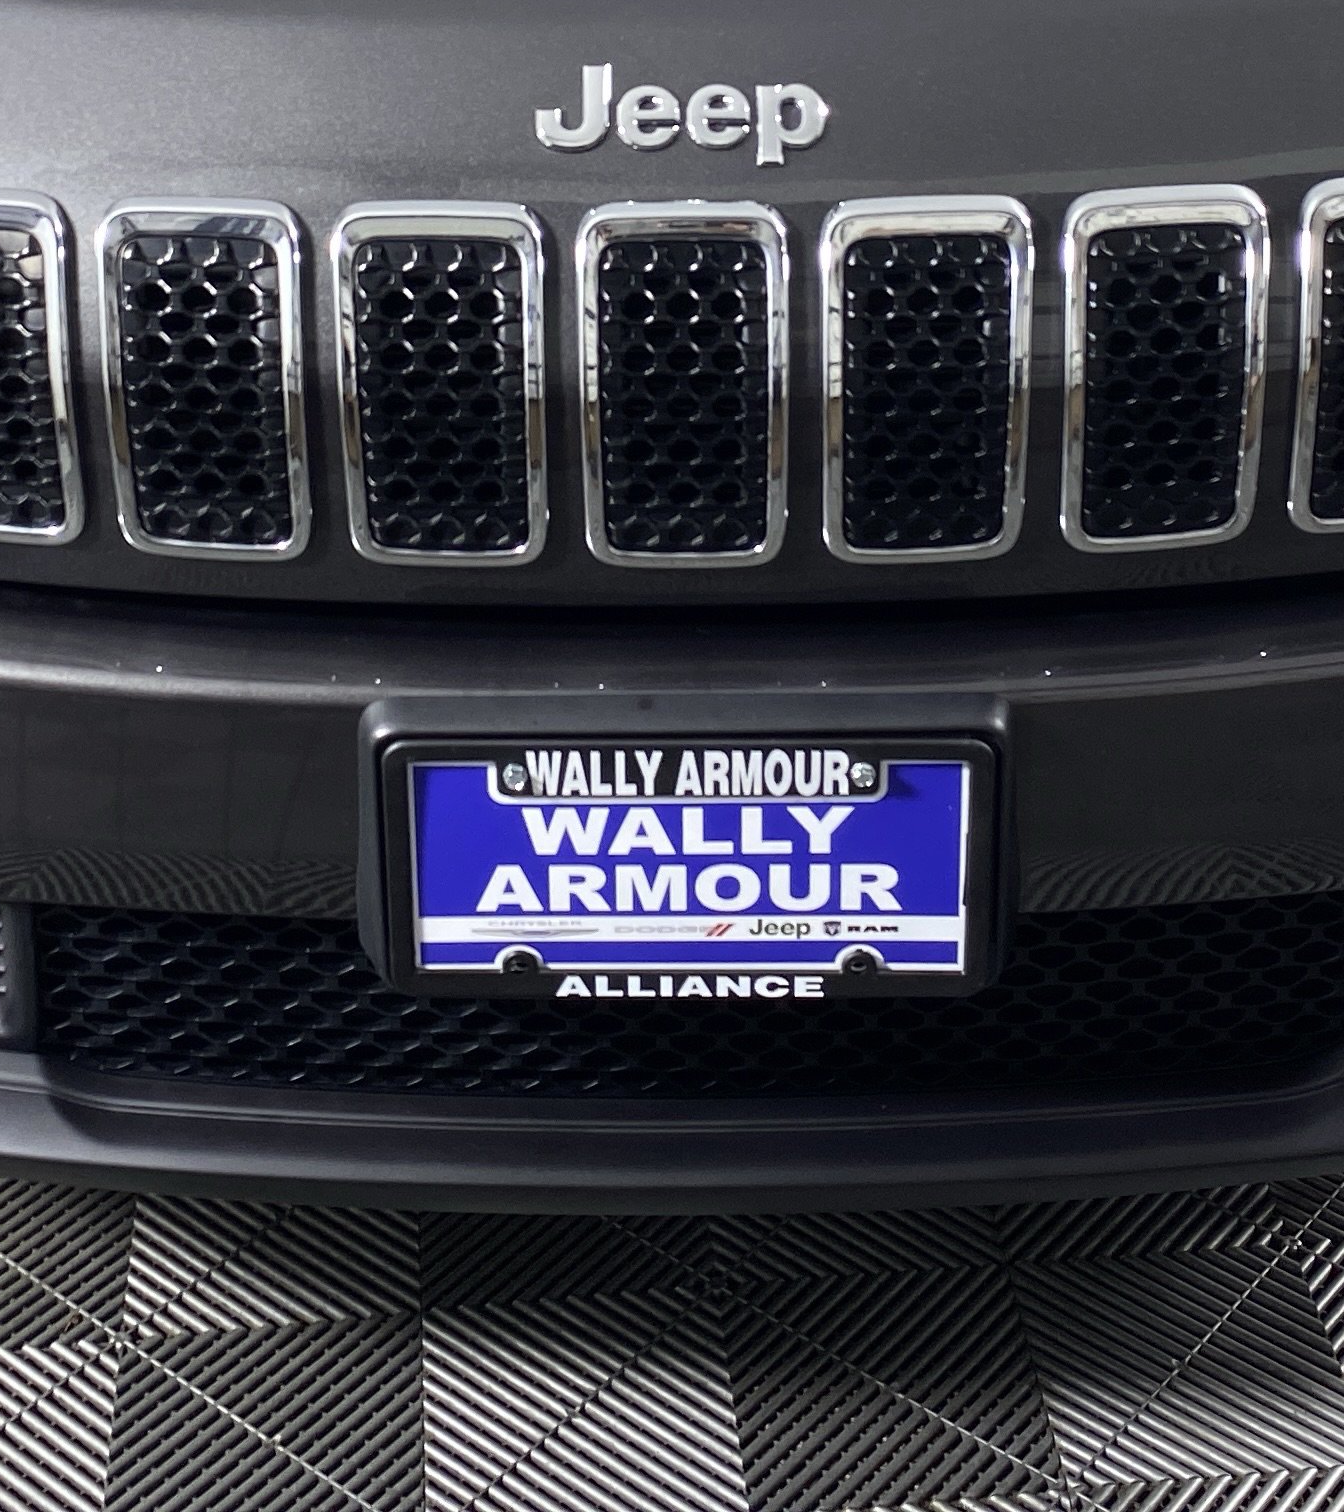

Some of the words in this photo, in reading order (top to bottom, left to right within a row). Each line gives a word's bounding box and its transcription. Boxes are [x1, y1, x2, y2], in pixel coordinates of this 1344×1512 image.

[535, 63, 829, 166] Jeep
[526, 750, 663, 796] WALLY
[675, 748, 850, 796] ARMOUR
[522, 806, 856, 856] WALLY
[475, 862, 903, 912] ARMOUR
[749, 919, 811, 939] Jeep
[847, 925, 899, 933] RAM
[556, 975, 825, 997] ALLIANCE
